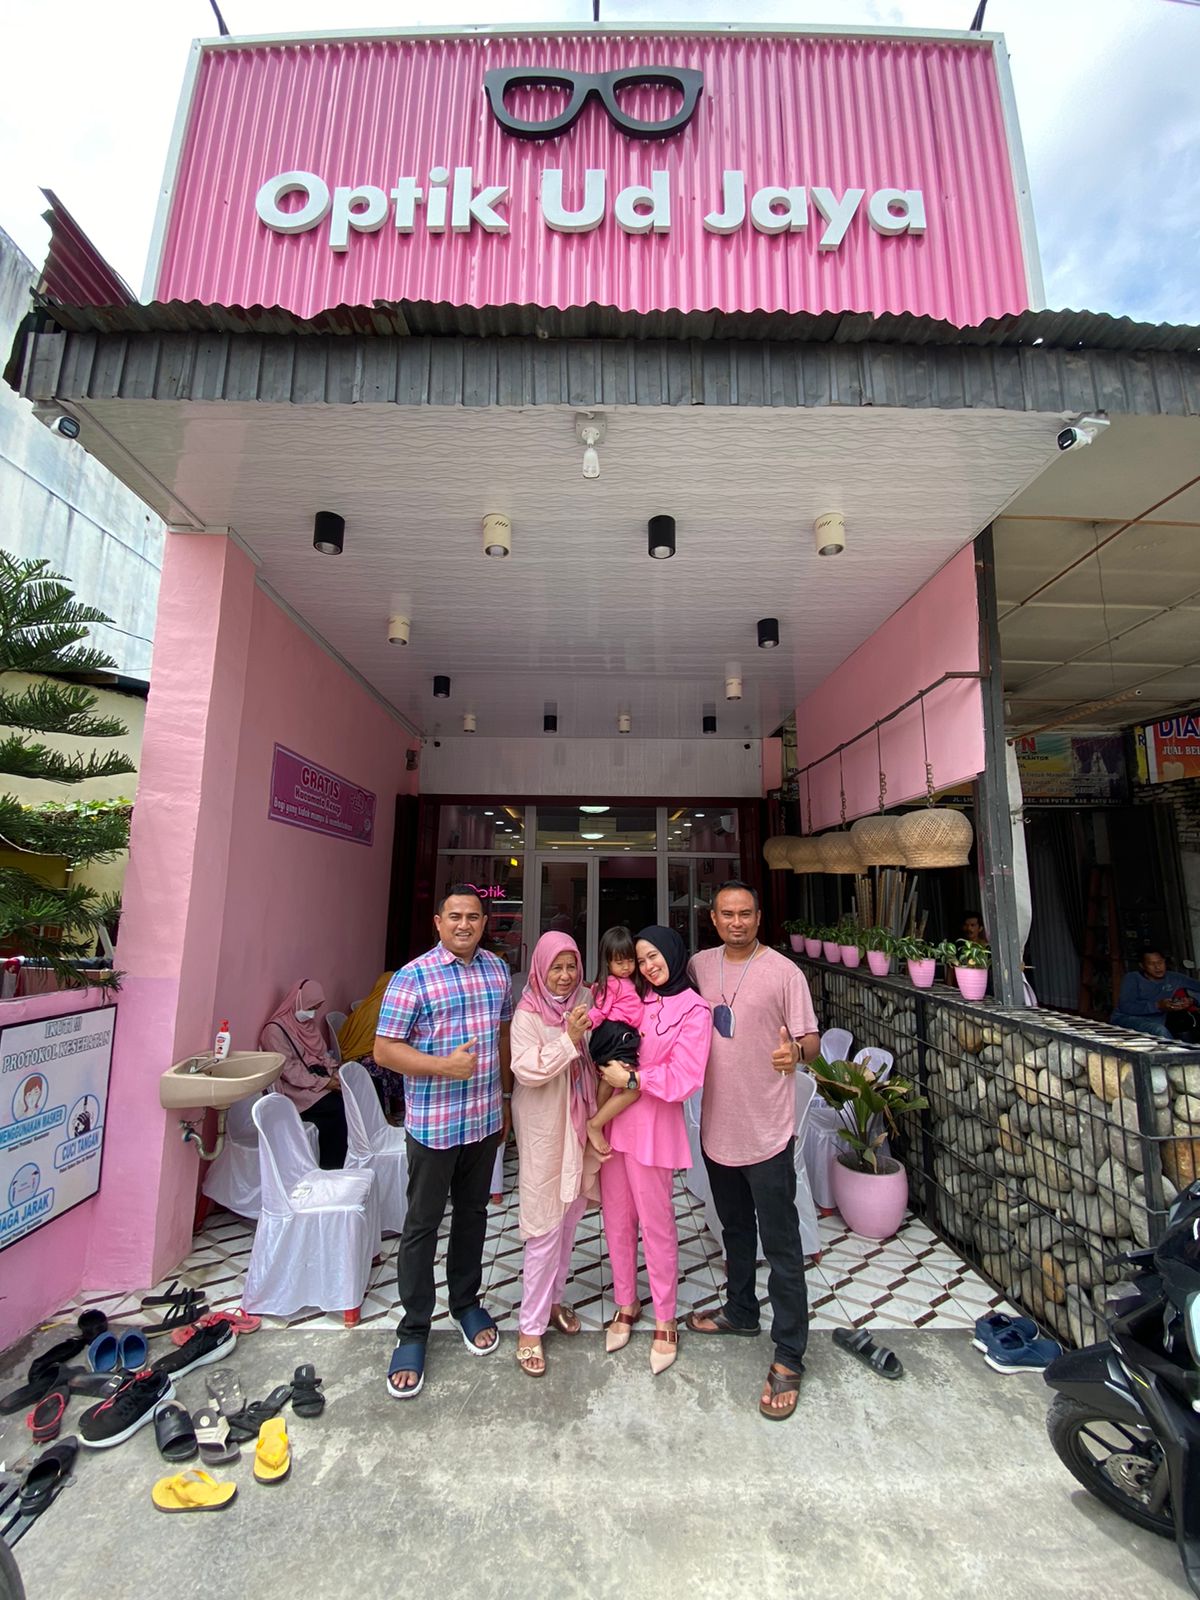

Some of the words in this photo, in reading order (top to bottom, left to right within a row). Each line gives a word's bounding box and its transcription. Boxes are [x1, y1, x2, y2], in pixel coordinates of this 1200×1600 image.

[255, 166, 510, 253] Optik
[540, 167, 671, 235] Ud
[703, 169, 928, 252] Jaya
[1163, 745, 1183, 755] JUAL
[301, 766, 340, 800] GRATIS
[2, 1043, 58, 1073] PROTOKOL
[58, 1029, 111, 1058] KESEHATAN
[62, 1141, 76, 1160] CUCI
[78, 1130, 99, 1153] TANGAN
[0, 1210, 20, 1233] AGA
[21, 1193, 50, 1222] JARAK
